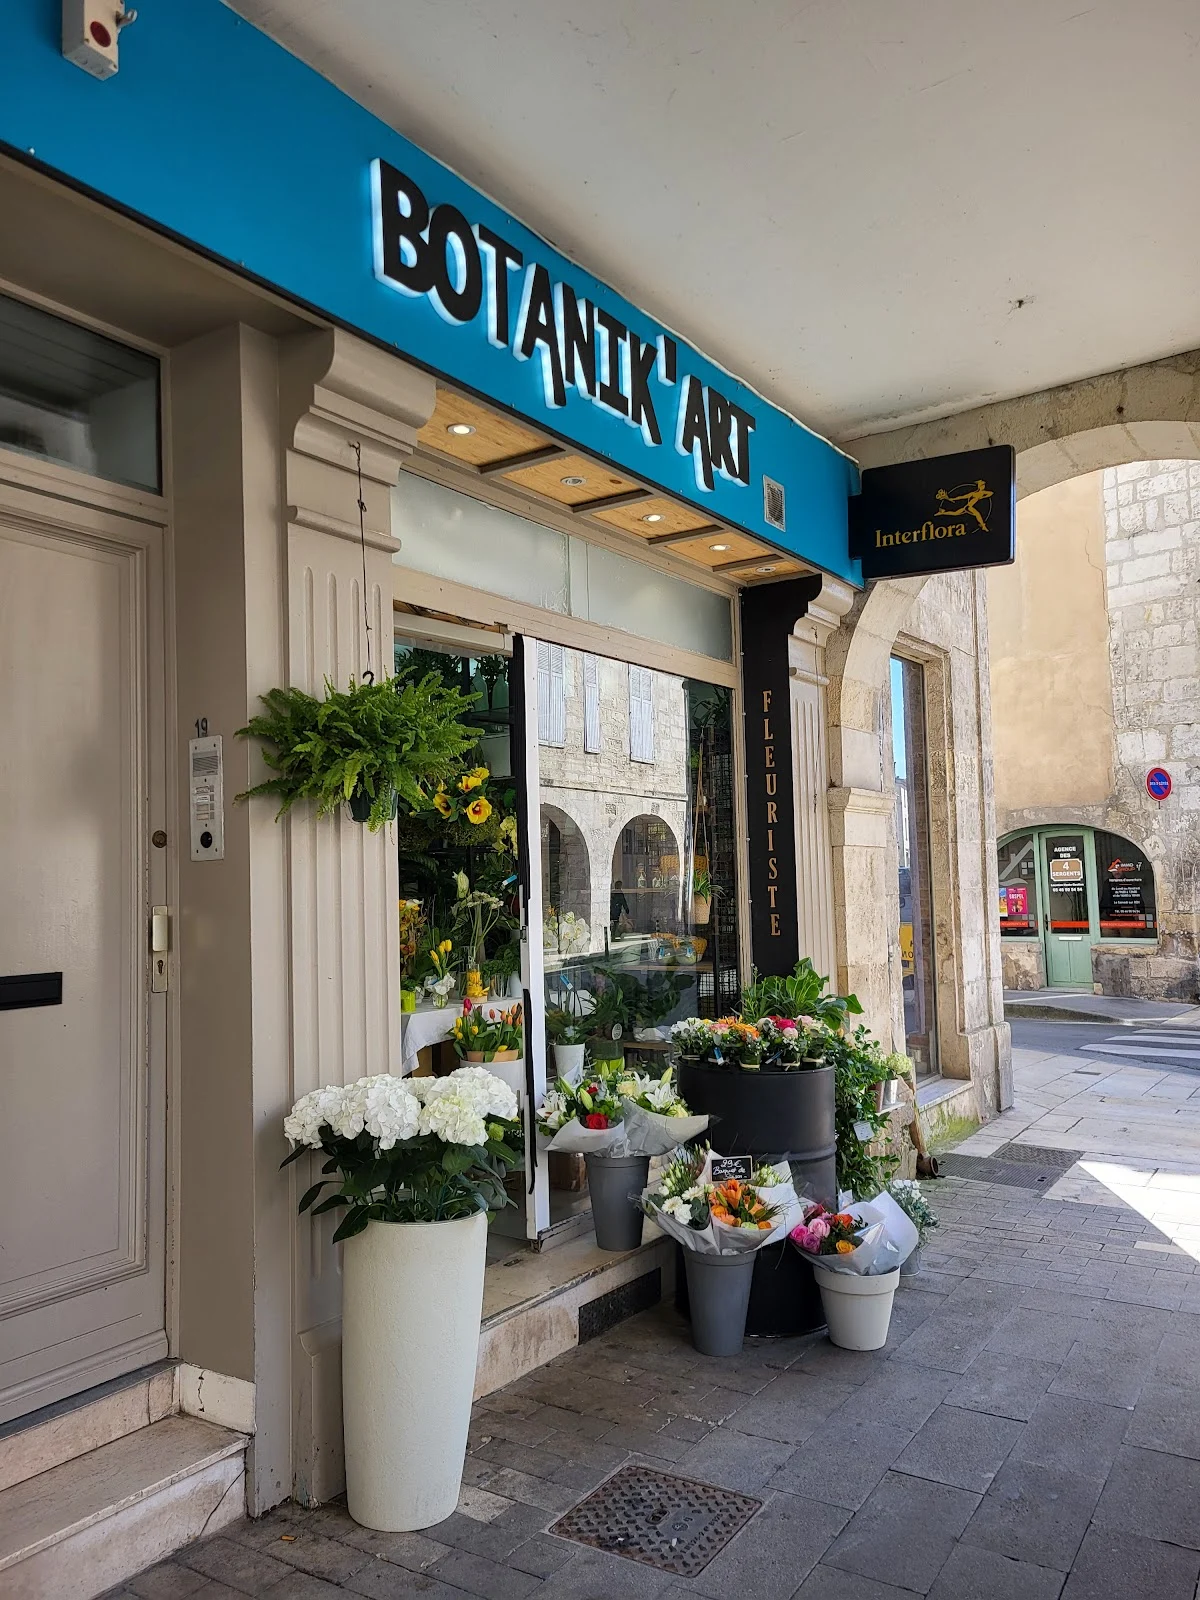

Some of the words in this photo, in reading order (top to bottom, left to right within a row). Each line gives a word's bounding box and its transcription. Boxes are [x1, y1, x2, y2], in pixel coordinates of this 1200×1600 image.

[675, 374, 756, 492] ART
[875, 521, 967, 548] Interflora
[194, 717, 208, 738] 19
[762, 689, 781, 937] FLEURISTE
[1062, 861, 1070, 870] 4
